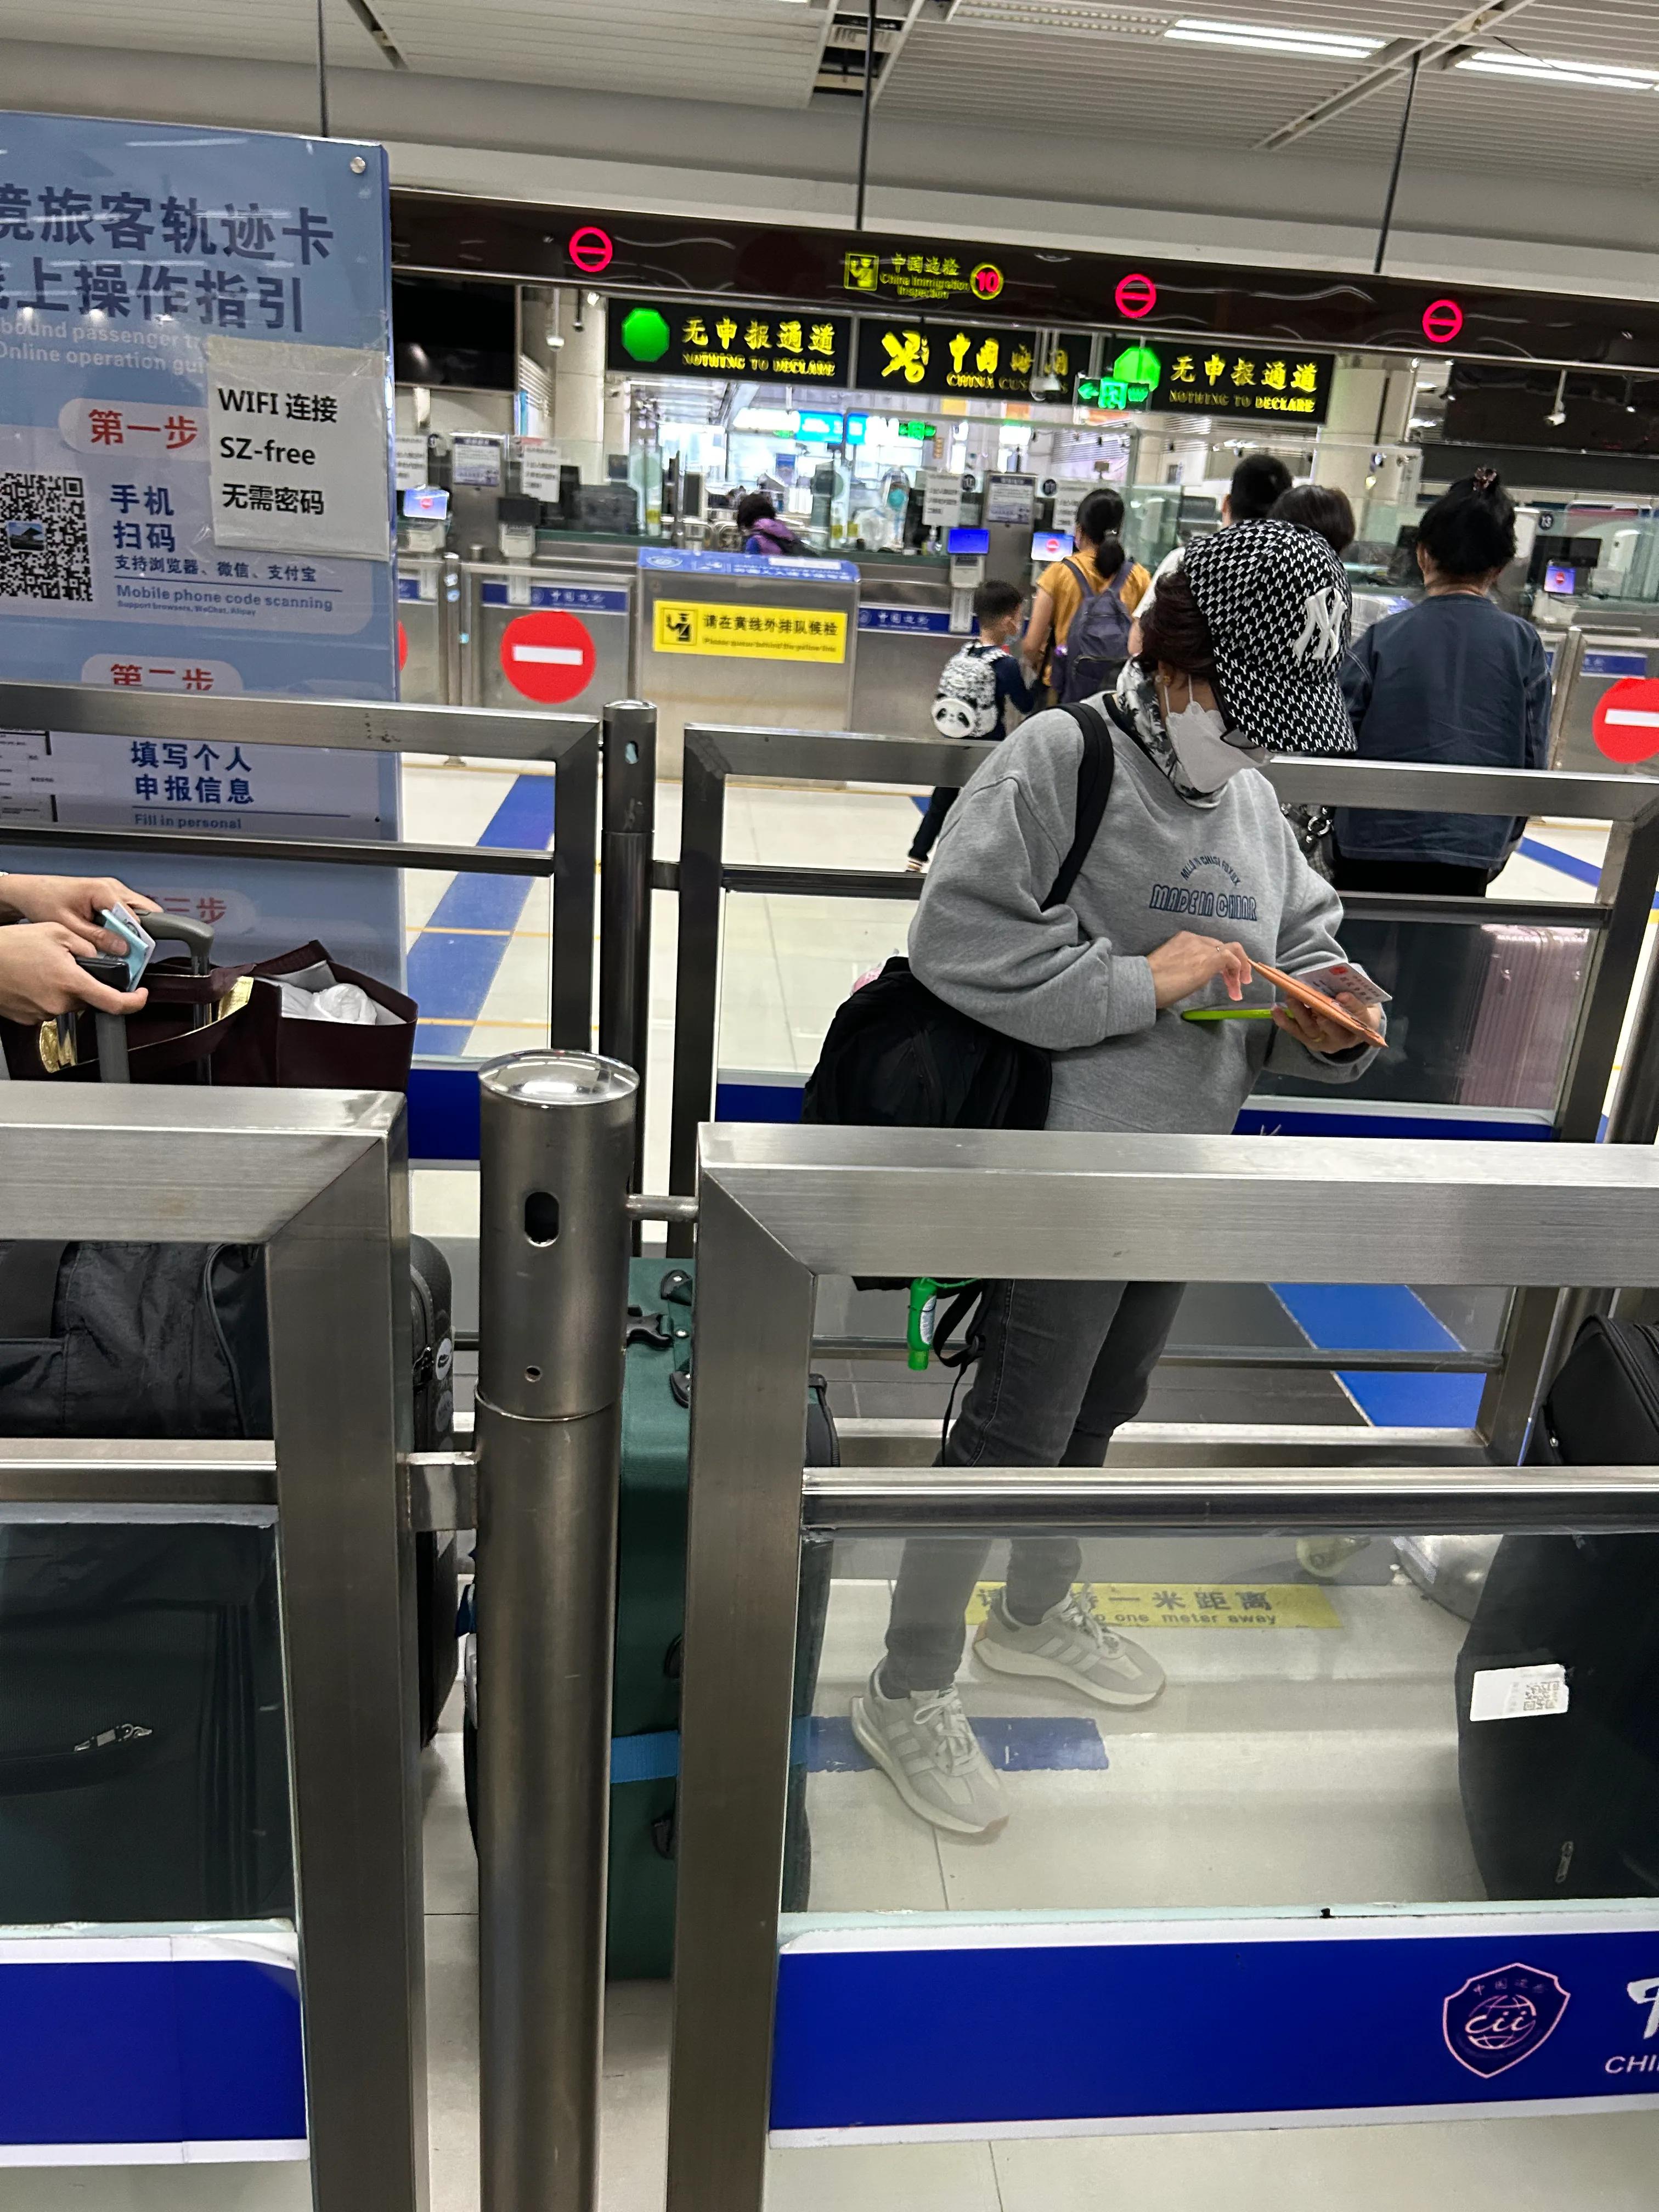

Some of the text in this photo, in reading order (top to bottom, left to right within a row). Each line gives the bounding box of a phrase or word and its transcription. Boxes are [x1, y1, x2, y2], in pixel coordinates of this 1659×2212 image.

[879, 273, 910, 286] China
[976, 271, 1000, 292] 10
[0, 257, 303, 332] 上操作指引
[72, 326, 179, 349] passenger
[682, 315, 836, 356] 无申报通道
[66, 350, 166, 370] operation
[172, 358, 206, 376] gui
[682, 351, 836, 377] NOTHING TO DECLARE
[1170, 353, 1318, 392] 无申报通道
[947, 371, 995, 390] CHINA
[218, 388, 338, 424] WIFI 连接
[1169, 389, 1229, 407] NOTHING
[1234, 394, 1252, 408] TO
[1255, 394, 1316, 413] DECLARE
[88, 409, 198, 449] 第一步
[220, 437, 316, 465] SZ-free
[110, 484, 174, 517] 手机
[222, 483, 325, 515] 无需密码
[114, 520, 176, 552] 扫码
[116, 585, 333, 612] Mobile phone code scanning
[117, 600, 150, 610] Support
[131, 741, 252, 772] 填写个人
[134, 774, 255, 805] 申报信息
[135, 814, 242, 830] Fill in personal
[1114, 1613, 1149, 1622] one
[1161, 1613, 1217, 1623] meter
[1227, 1614, 1276, 1625] away
[1605, 2054, 1659, 2074] CHI
